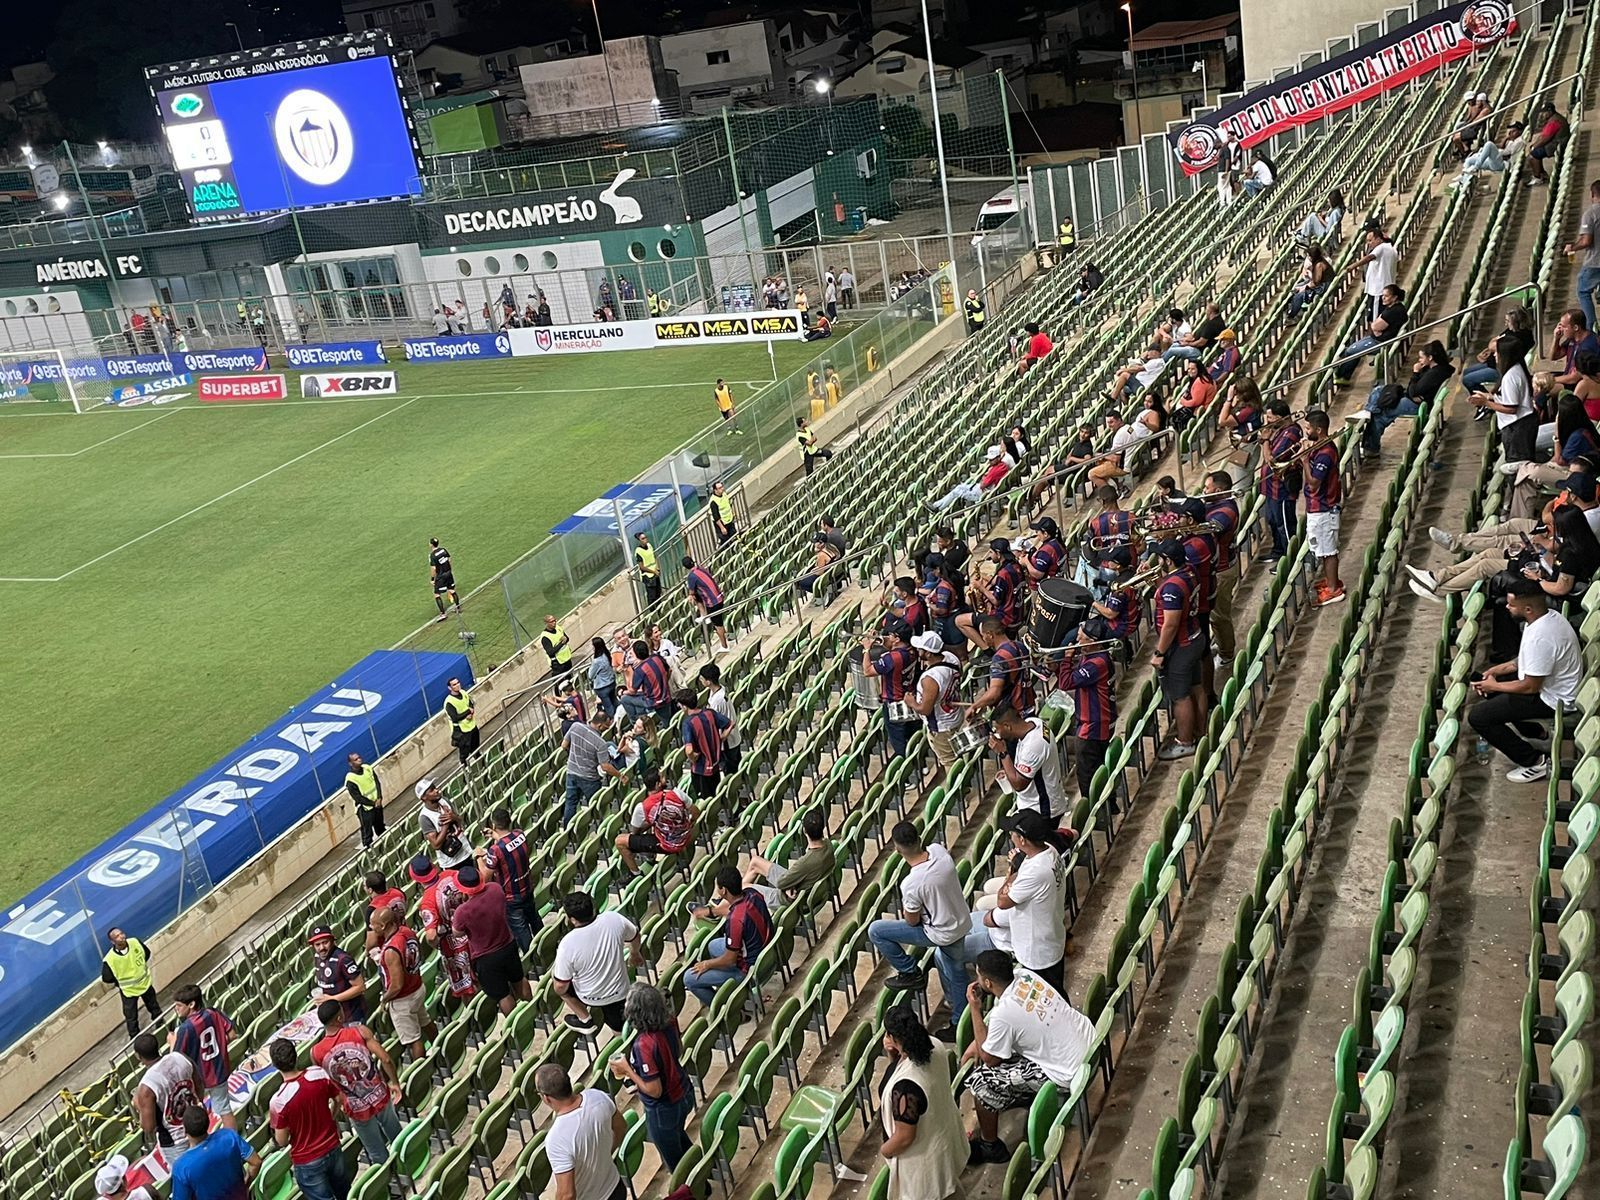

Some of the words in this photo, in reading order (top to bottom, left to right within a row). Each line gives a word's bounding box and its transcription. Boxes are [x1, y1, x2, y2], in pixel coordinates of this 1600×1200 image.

[1378, 22, 1457, 77] ITABIRITO
[164, 75, 194, 89] AMÉRICA
[193, 71, 224, 84] FUTEBOL
[224, 66, 246, 79] CLUBE
[252, 63, 275, 75] ARENA
[193, 182, 237, 203] ARENA
[444, 195, 598, 235] DECACAMPEÃO
[36, 256, 108, 284] AMÉRICA
[116, 254, 143, 275] FC
[657, 323, 698, 337] MSA
[704, 320, 747, 334] MSA
[753, 317, 796, 331] MSA
[553, 327, 624, 341] HERCULANO
[411, 340, 480, 358] BETesporte
[554, 339, 603, 350] MINERAÇÃO
[194, 352, 255, 373] BETesporte
[300, 347, 364, 366] BETesporte
[117, 358, 173, 377] BETesporte
[201, 379, 279, 396] SUPERBET
[324, 376, 392, 393] XBRI
[2, 903, 95, 946] É
[87, 687, 382, 888] GERDAU
[200, 1026, 220, 1061] 9
